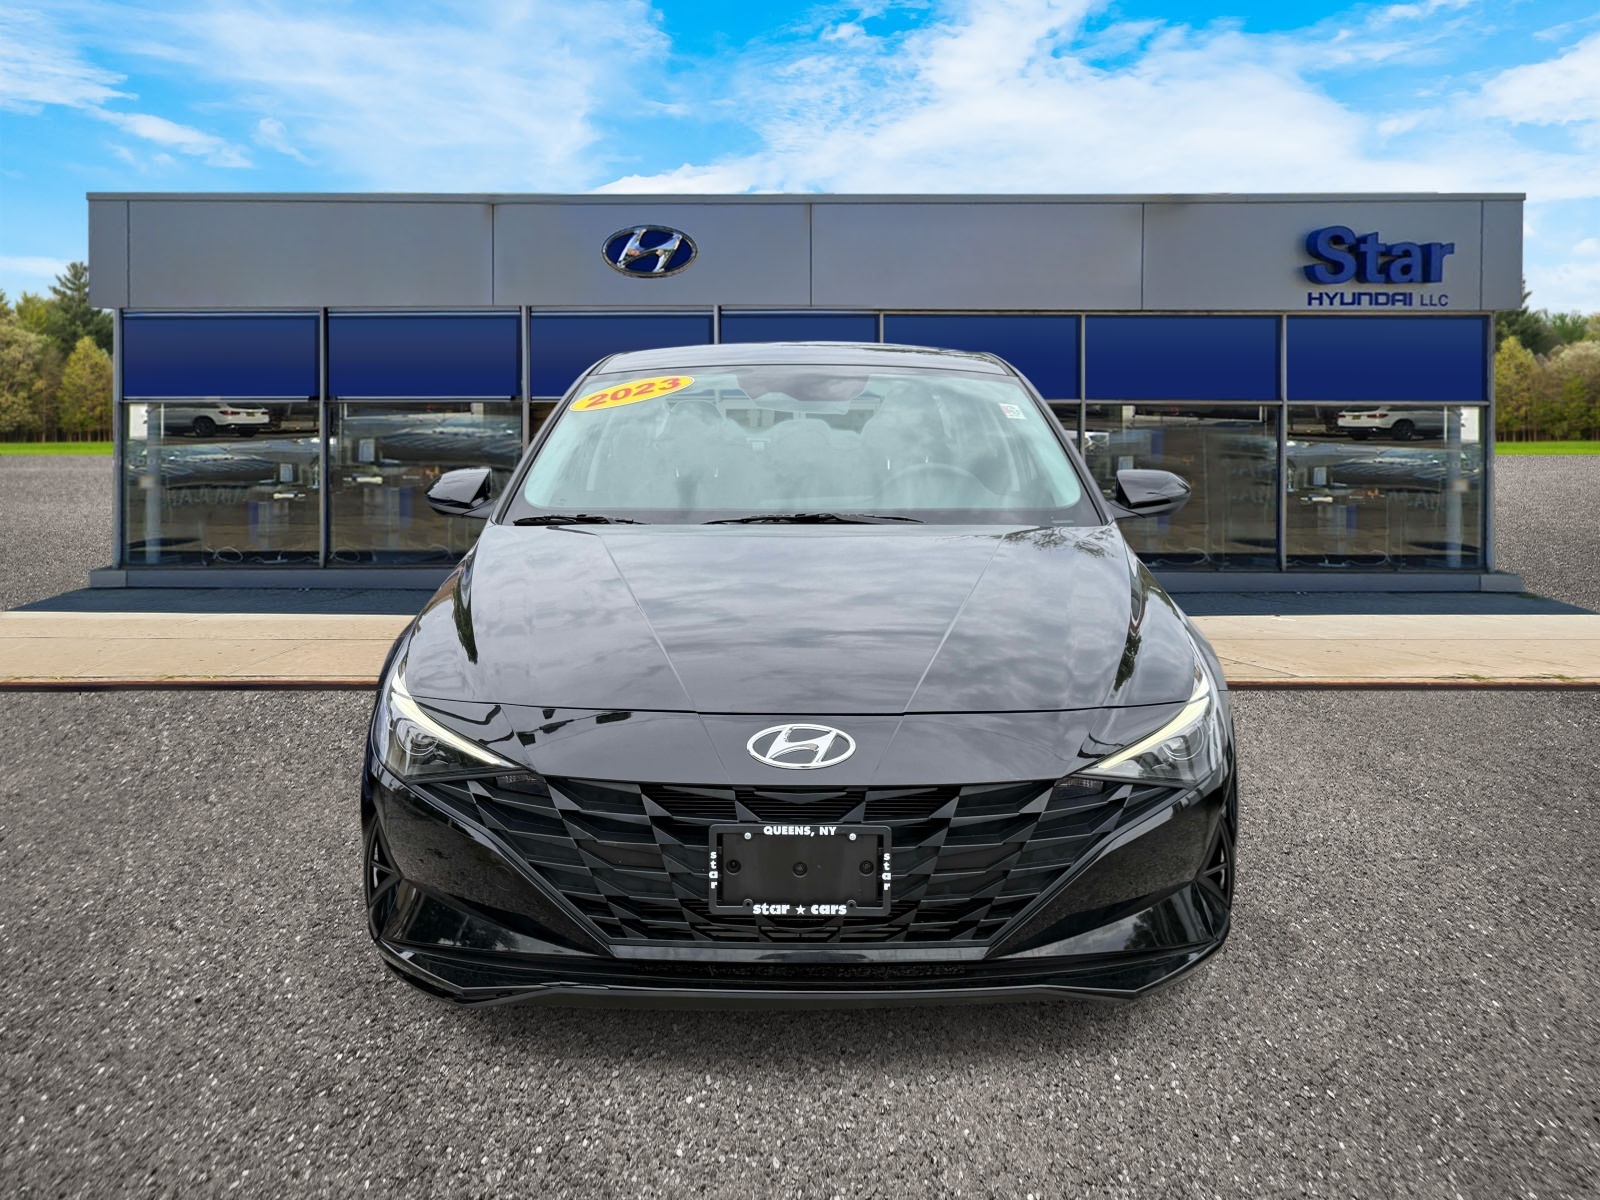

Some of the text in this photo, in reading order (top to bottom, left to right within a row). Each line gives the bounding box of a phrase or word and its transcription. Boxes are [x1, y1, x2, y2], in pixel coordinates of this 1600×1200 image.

[1303, 225, 1455, 284] Star
[1307, 292, 1449, 306] HYUNDAI LLC
[584, 377, 681, 409] 2023
[763, 826, 837, 837] QUEENS, NY
[708, 851, 719, 889] star
[881, 853, 892, 891] star
[752, 904, 847, 915] star cars
